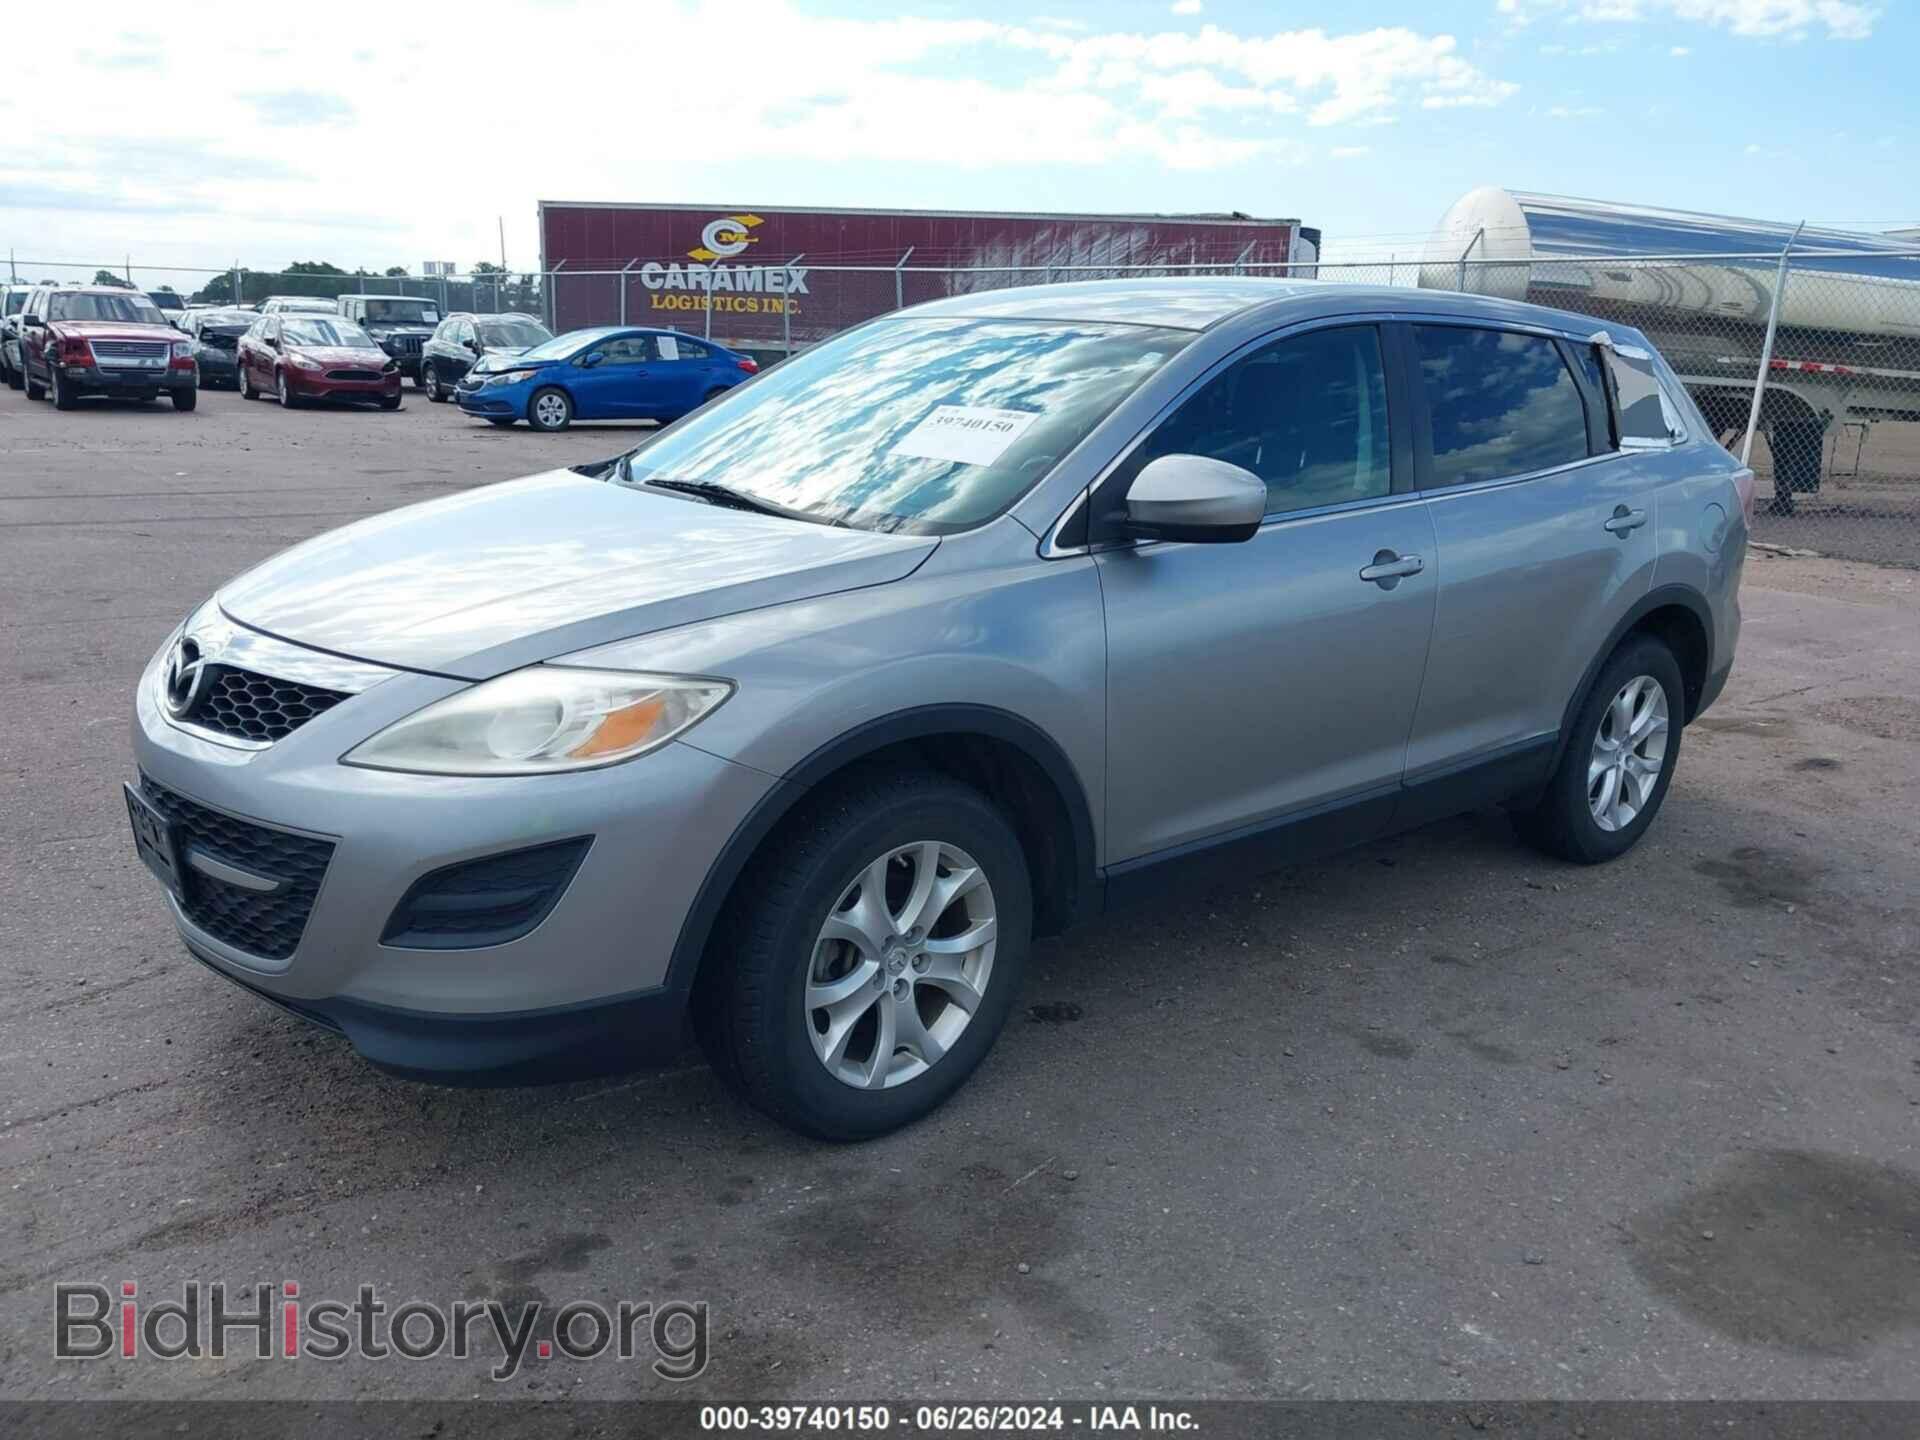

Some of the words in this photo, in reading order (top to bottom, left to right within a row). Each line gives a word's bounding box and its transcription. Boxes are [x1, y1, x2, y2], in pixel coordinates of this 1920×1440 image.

[640, 262, 809, 294] CARAMEX
[651, 294, 759, 313] LOGISTICS
[763, 298, 802, 315] INC.
